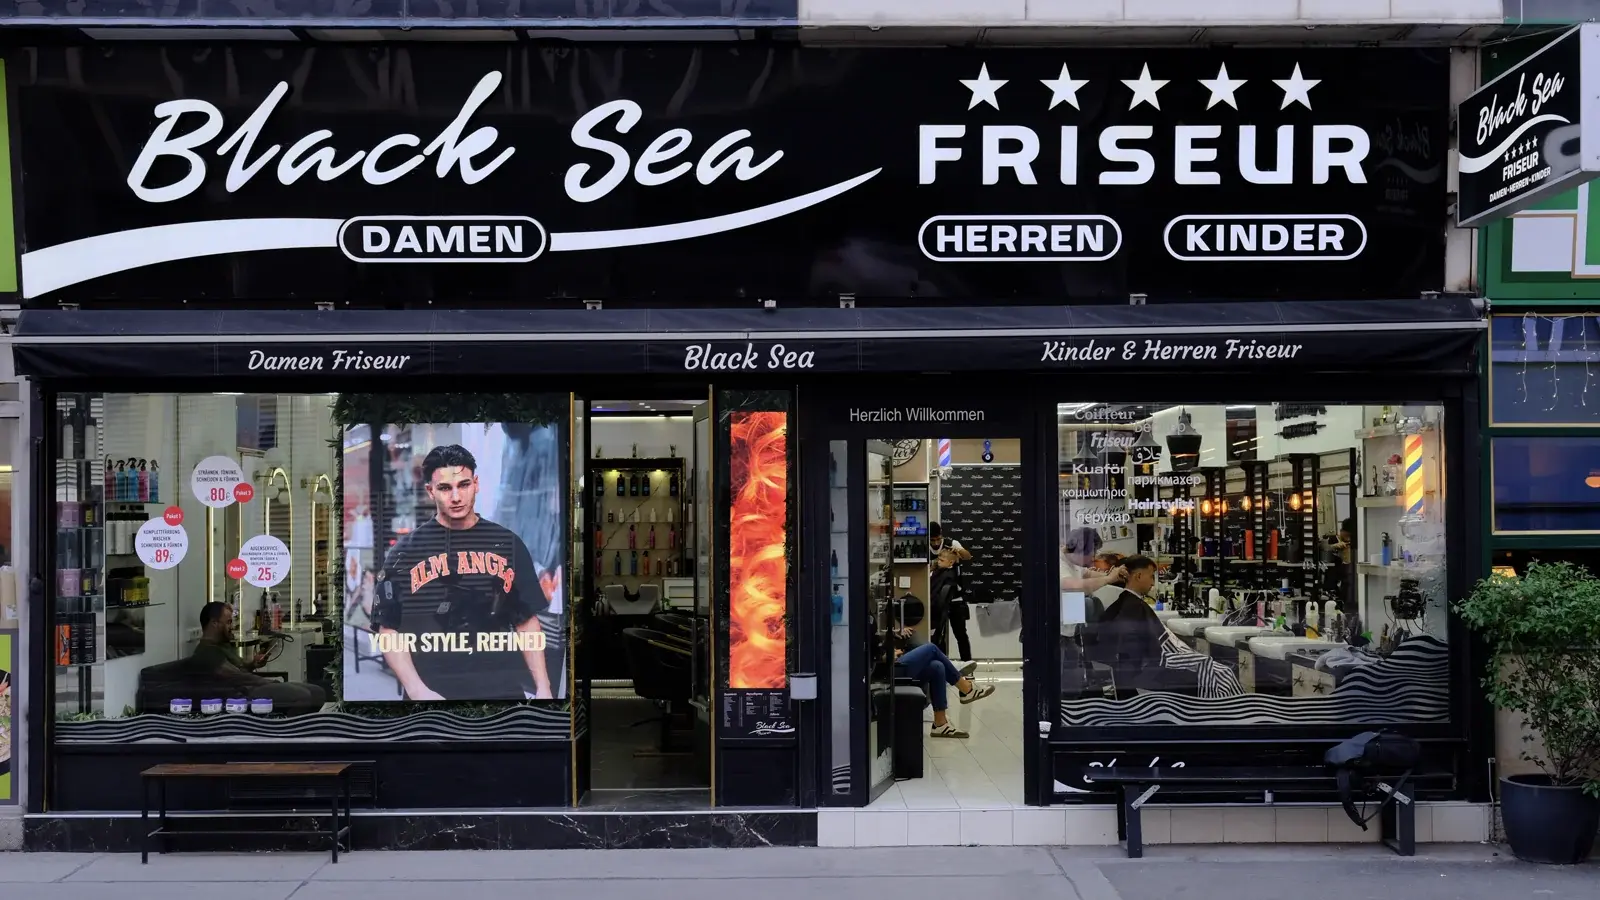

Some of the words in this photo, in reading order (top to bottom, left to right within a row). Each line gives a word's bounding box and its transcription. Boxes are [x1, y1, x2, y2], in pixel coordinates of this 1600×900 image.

[1476, 72, 1528, 146] Black
[1532, 72, 1565, 116] Sea
[127, 71, 515, 203] Black
[564, 99, 784, 203] Sea
[919, 124, 1370, 186] FRISEUR
[1502, 151, 1540, 182] FRISEUR
[362, 225, 524, 254] DAMEN
[937, 224, 1105, 253] HERREN
[1186, 224, 1344, 253] KINDER
[248, 350, 325, 371] Damen
[331, 349, 411, 372] Friseur
[684, 344, 759, 371] Black
[768, 344, 815, 370] Sea
[1041, 340, 1115, 362] Kinder
[1121, 341, 1137, 361] &
[1142, 340, 1217, 362] Herren
[1225, 338, 1303, 361] Friseur
[849, 408, 902, 422] Herzlich
[905, 407, 985, 422] Willkommen
[1075, 407, 1135, 420] Coiffeur
[1090, 432, 1135, 448] Friseur
[1072, 463, 1128, 474] Kuaför
[1127, 475, 1201, 487] парикмахер
[1127, 498, 1195, 510] Hairstylist
[1077, 512, 1130, 525] перукар
[410, 552, 450, 594] ALM
[368, 632, 417, 653] YOUR
[420, 632, 473, 655] STYLE,
[477, 631, 546, 652] REFINED
